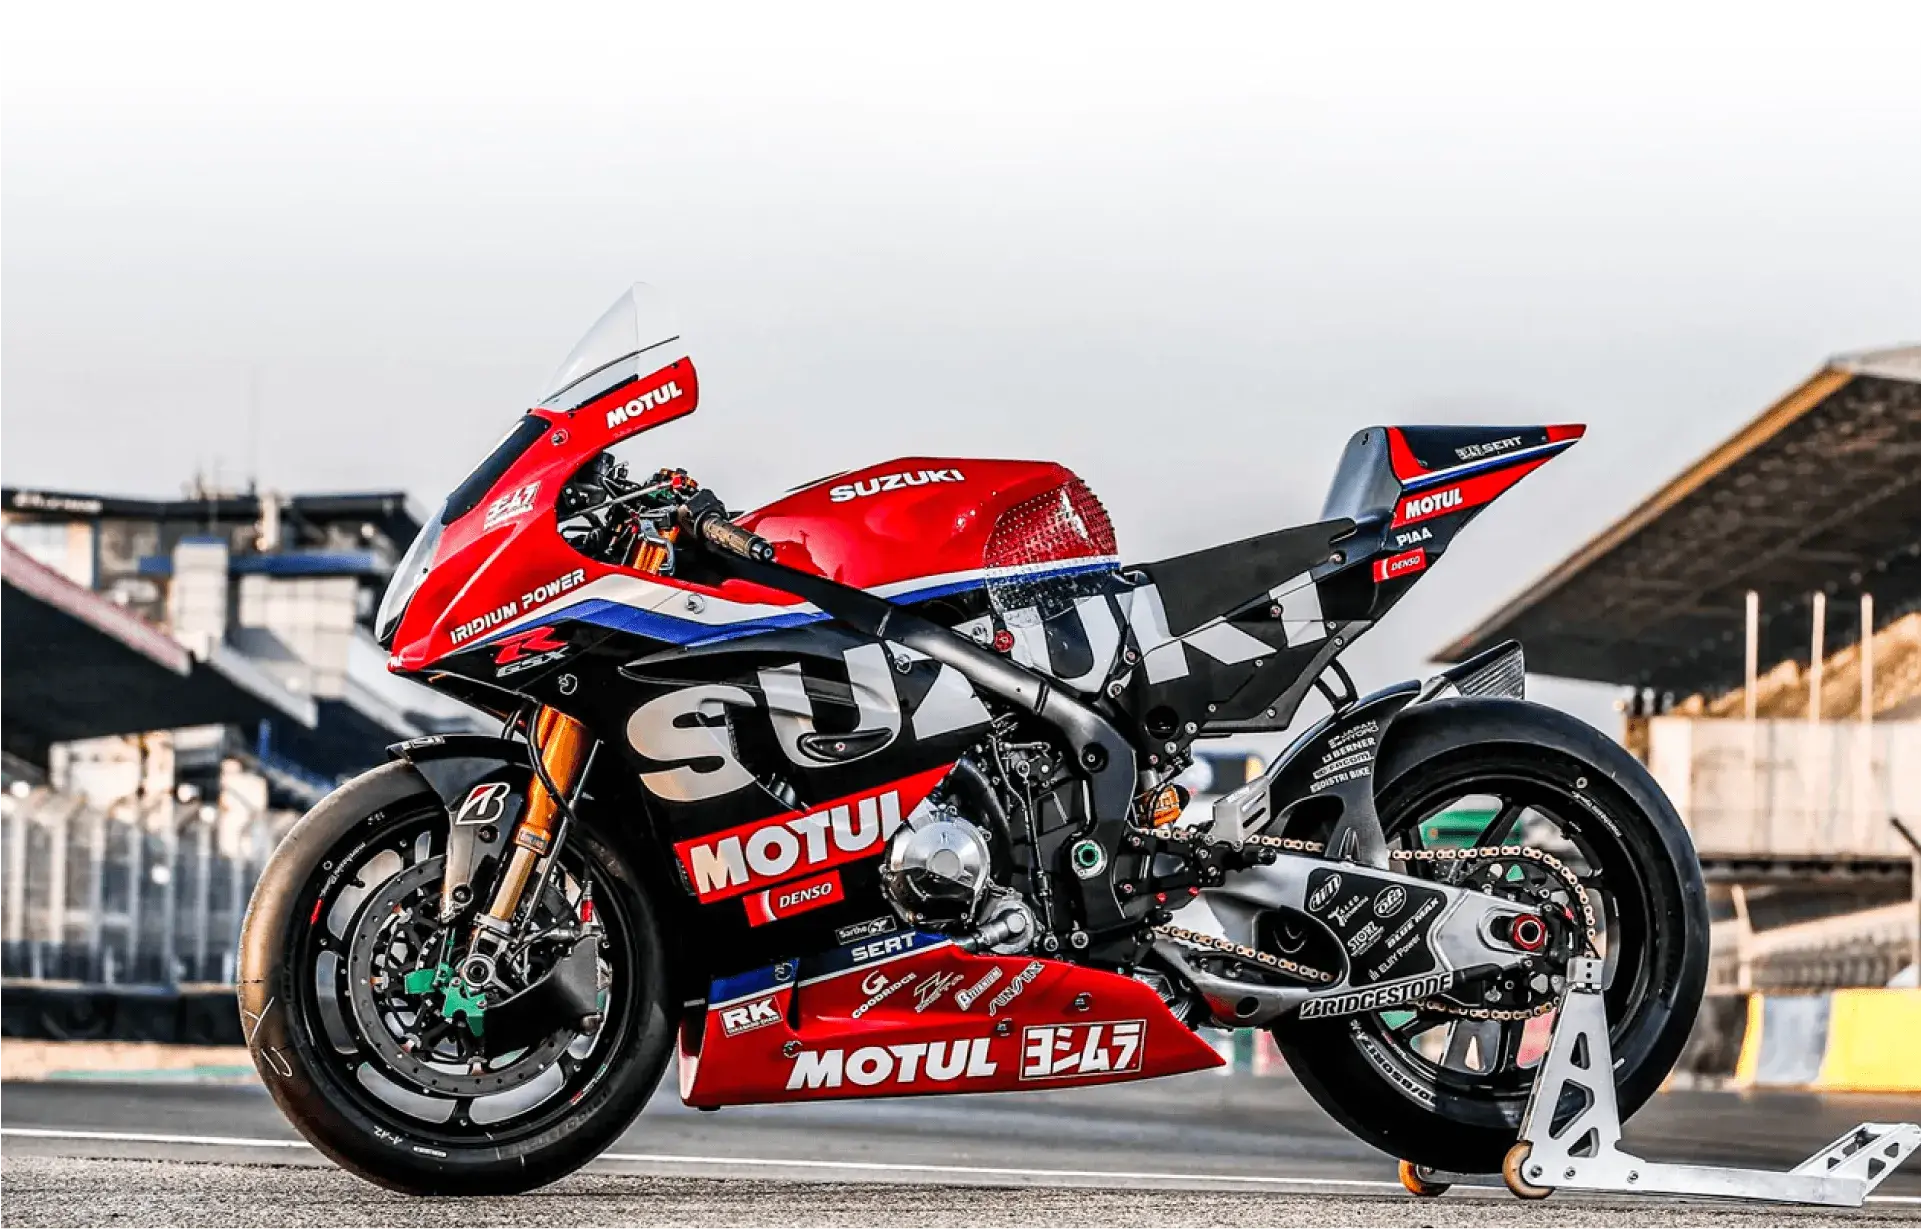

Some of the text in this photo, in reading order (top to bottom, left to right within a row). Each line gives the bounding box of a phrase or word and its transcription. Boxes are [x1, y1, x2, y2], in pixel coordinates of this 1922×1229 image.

[606, 381, 683, 429] MOTUL
[1482, 436, 1522, 454] SERT
[829, 468, 965, 502] SUZUKI
[1405, 488, 1463, 520] MOTUL
[1396, 526, 1433, 547] PIAA
[1391, 556, 1421, 571] DENSO
[450, 568, 585, 645] IRIDIUM POWER
[1333, 737, 1376, 758] BERNER
[778, 882, 833, 909] DENSO
[851, 931, 916, 962] SERT
[852, 972, 918, 1019] GOODRIDGE
[1300, 974, 1453, 1018] BRIDGESTONE
[722, 997, 780, 1030] RK
[784, 1037, 998, 1090] MOTUL
[1025, 1023, 1140, 1077] ヨシムラ
